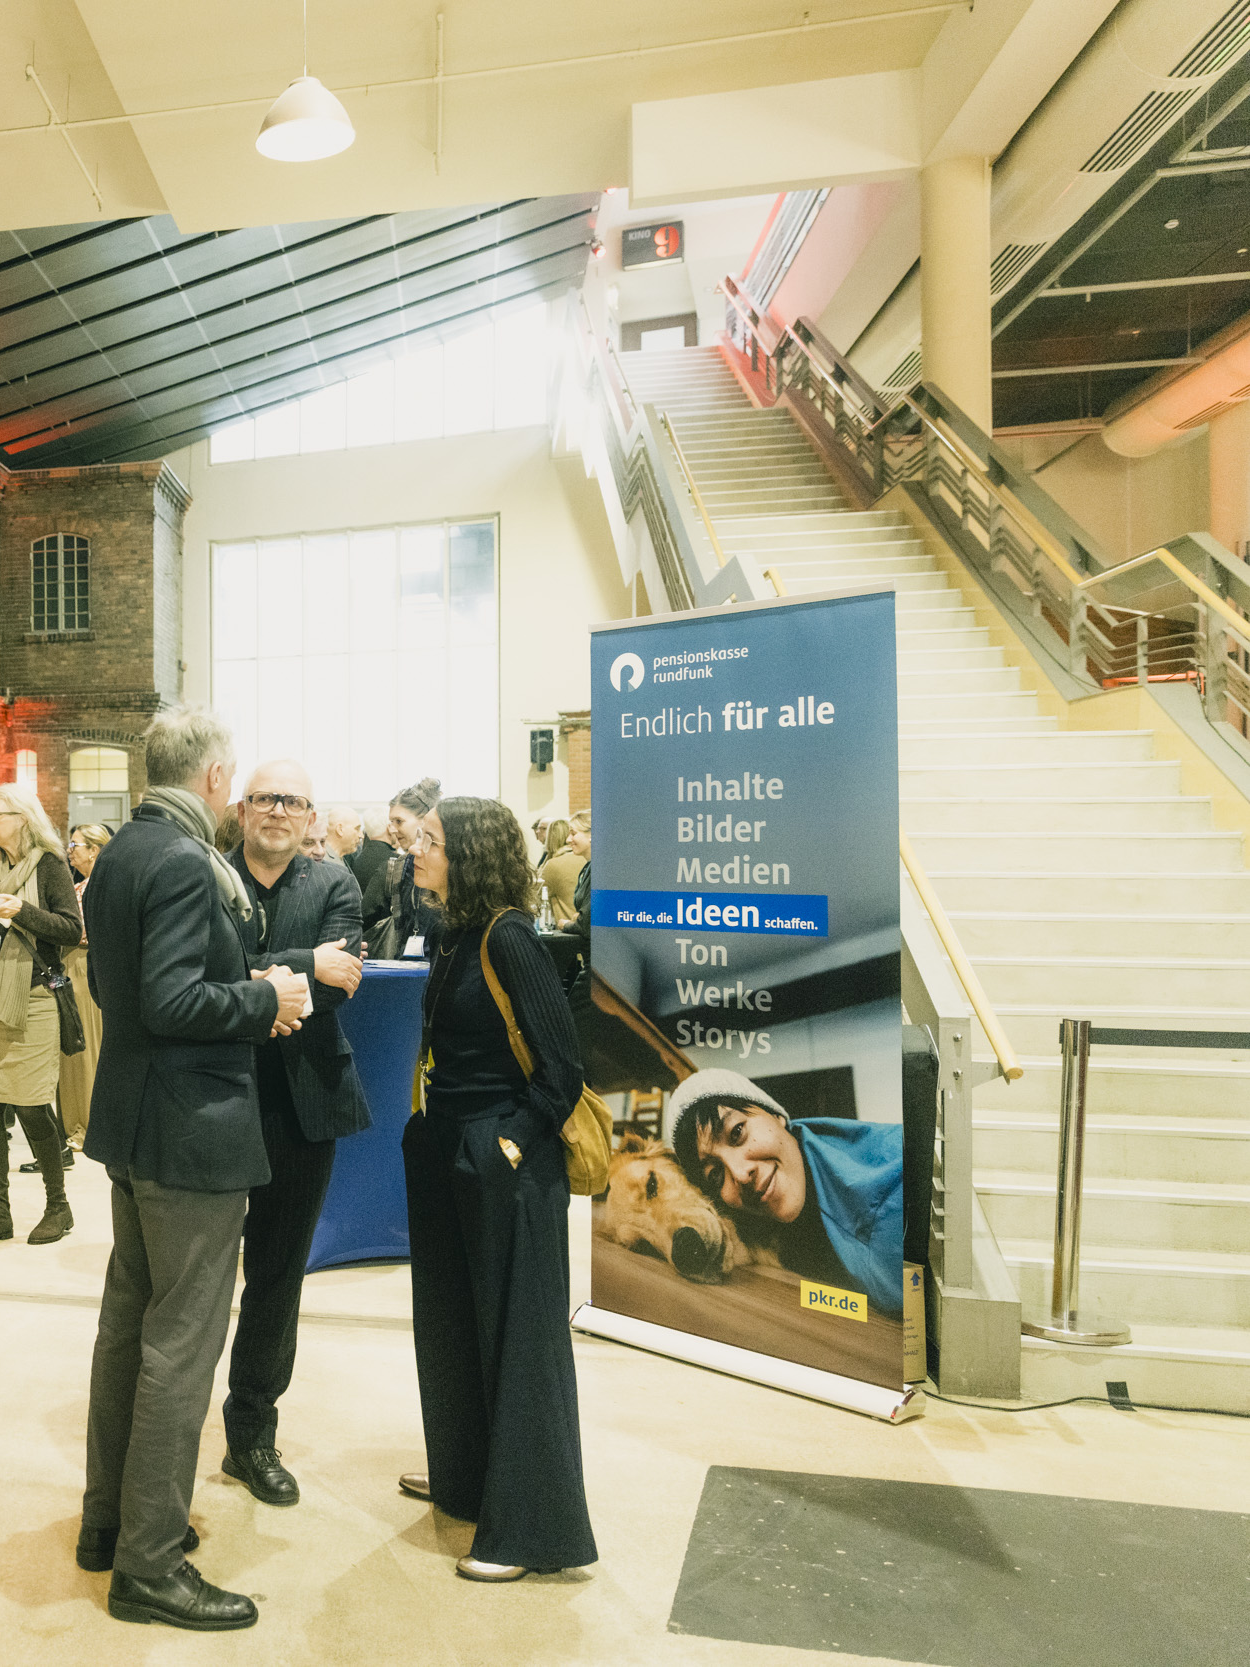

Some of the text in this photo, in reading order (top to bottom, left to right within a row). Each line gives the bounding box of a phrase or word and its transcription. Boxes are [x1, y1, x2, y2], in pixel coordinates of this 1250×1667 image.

[629, 226, 679, 258] KINO 9
[652, 646, 749, 670] pensionskasse
[652, 666, 713, 684] rundfunk
[620, 695, 835, 738] Endlich für alle
[677, 772, 784, 802] Inhalte
[677, 814, 767, 842] Bilder
[676, 854, 790, 885] Medien
[617, 897, 819, 931] Für die, die Ideen schaffen.
[675, 938, 728, 967] Ton
[675, 978, 773, 1012] Werke
[676, 1019, 772, 1059] Storys
[809, 1290, 859, 1313] pkr.de
